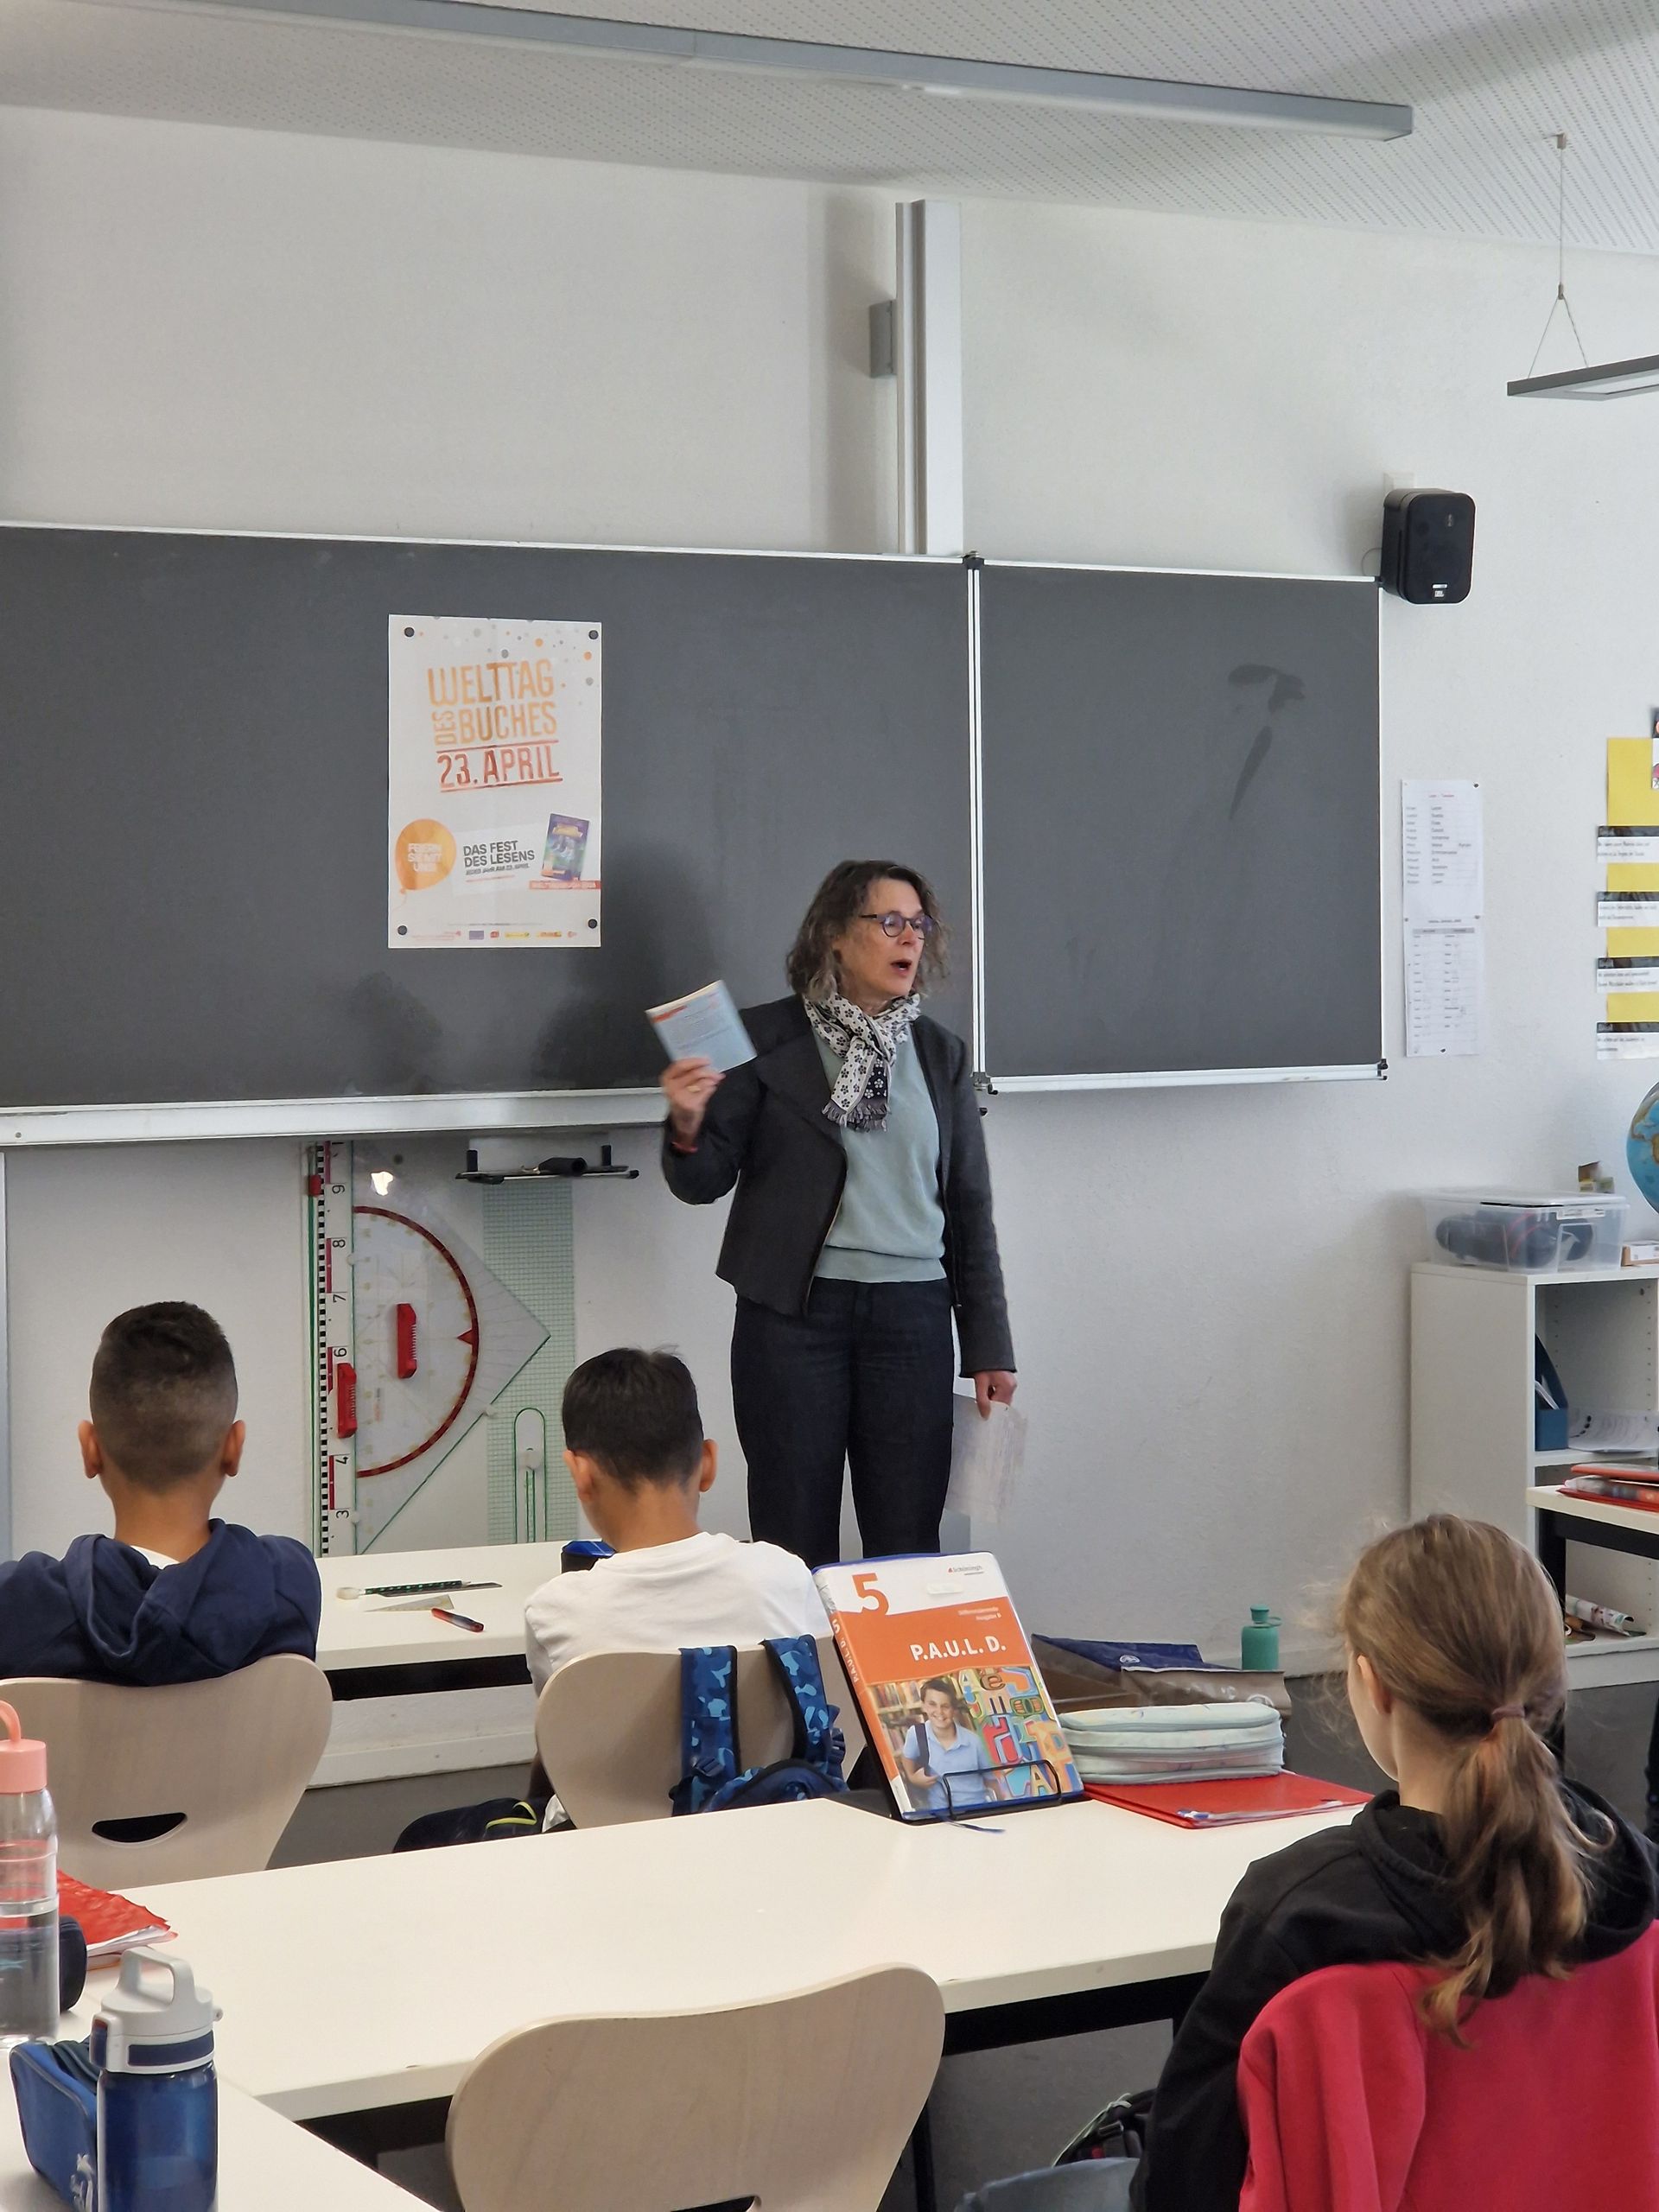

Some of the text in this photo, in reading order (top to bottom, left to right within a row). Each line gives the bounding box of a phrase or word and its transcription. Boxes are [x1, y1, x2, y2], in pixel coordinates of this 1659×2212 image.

[428, 658, 555, 707] WELTTAG
[431, 709, 456, 747] DES
[458, 701, 557, 744] BUCHES
[436, 745, 560, 788] 23. APRIL
[463, 840, 518, 856] DAS FEST
[464, 849, 535, 868] DES LESENS
[332, 1185, 346, 1194] 9
[332, 1239, 346, 1248] 8
[333, 1294, 346, 1303] 7
[334, 1347, 347, 1357] 6
[335, 1456, 349, 1465] 4
[335, 1510, 350, 1519] 3
[852, 1572, 889, 1616] 5
[910, 1636, 1007, 1661] P.A.U.L. D.
